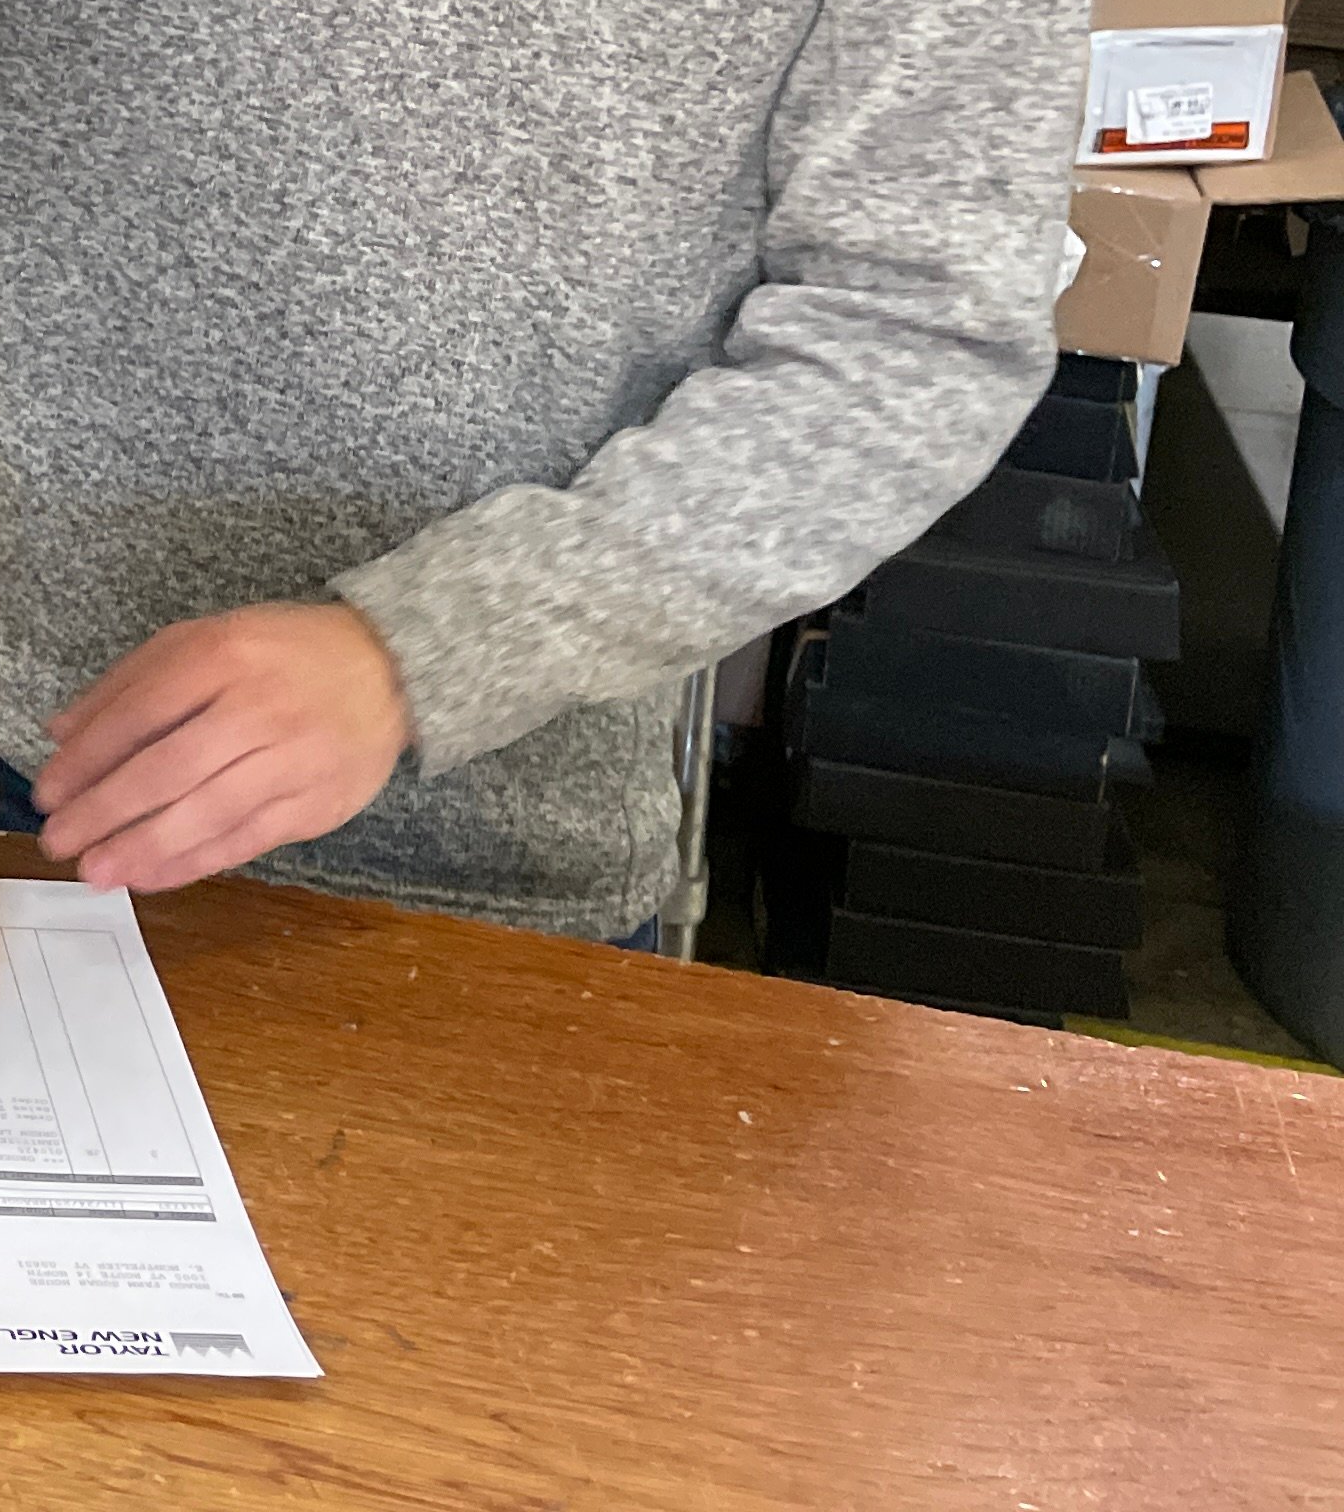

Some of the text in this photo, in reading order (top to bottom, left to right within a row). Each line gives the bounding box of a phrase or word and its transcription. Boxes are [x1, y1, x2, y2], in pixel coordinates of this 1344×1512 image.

[74, 1262, 90, 1270] VT
[151, 1272, 167, 1280] VT
[128, 1281, 161, 1289] FARM
[91, 1330, 163, 1344] NEW
[57, 1343, 170, 1357] TAYLOR
